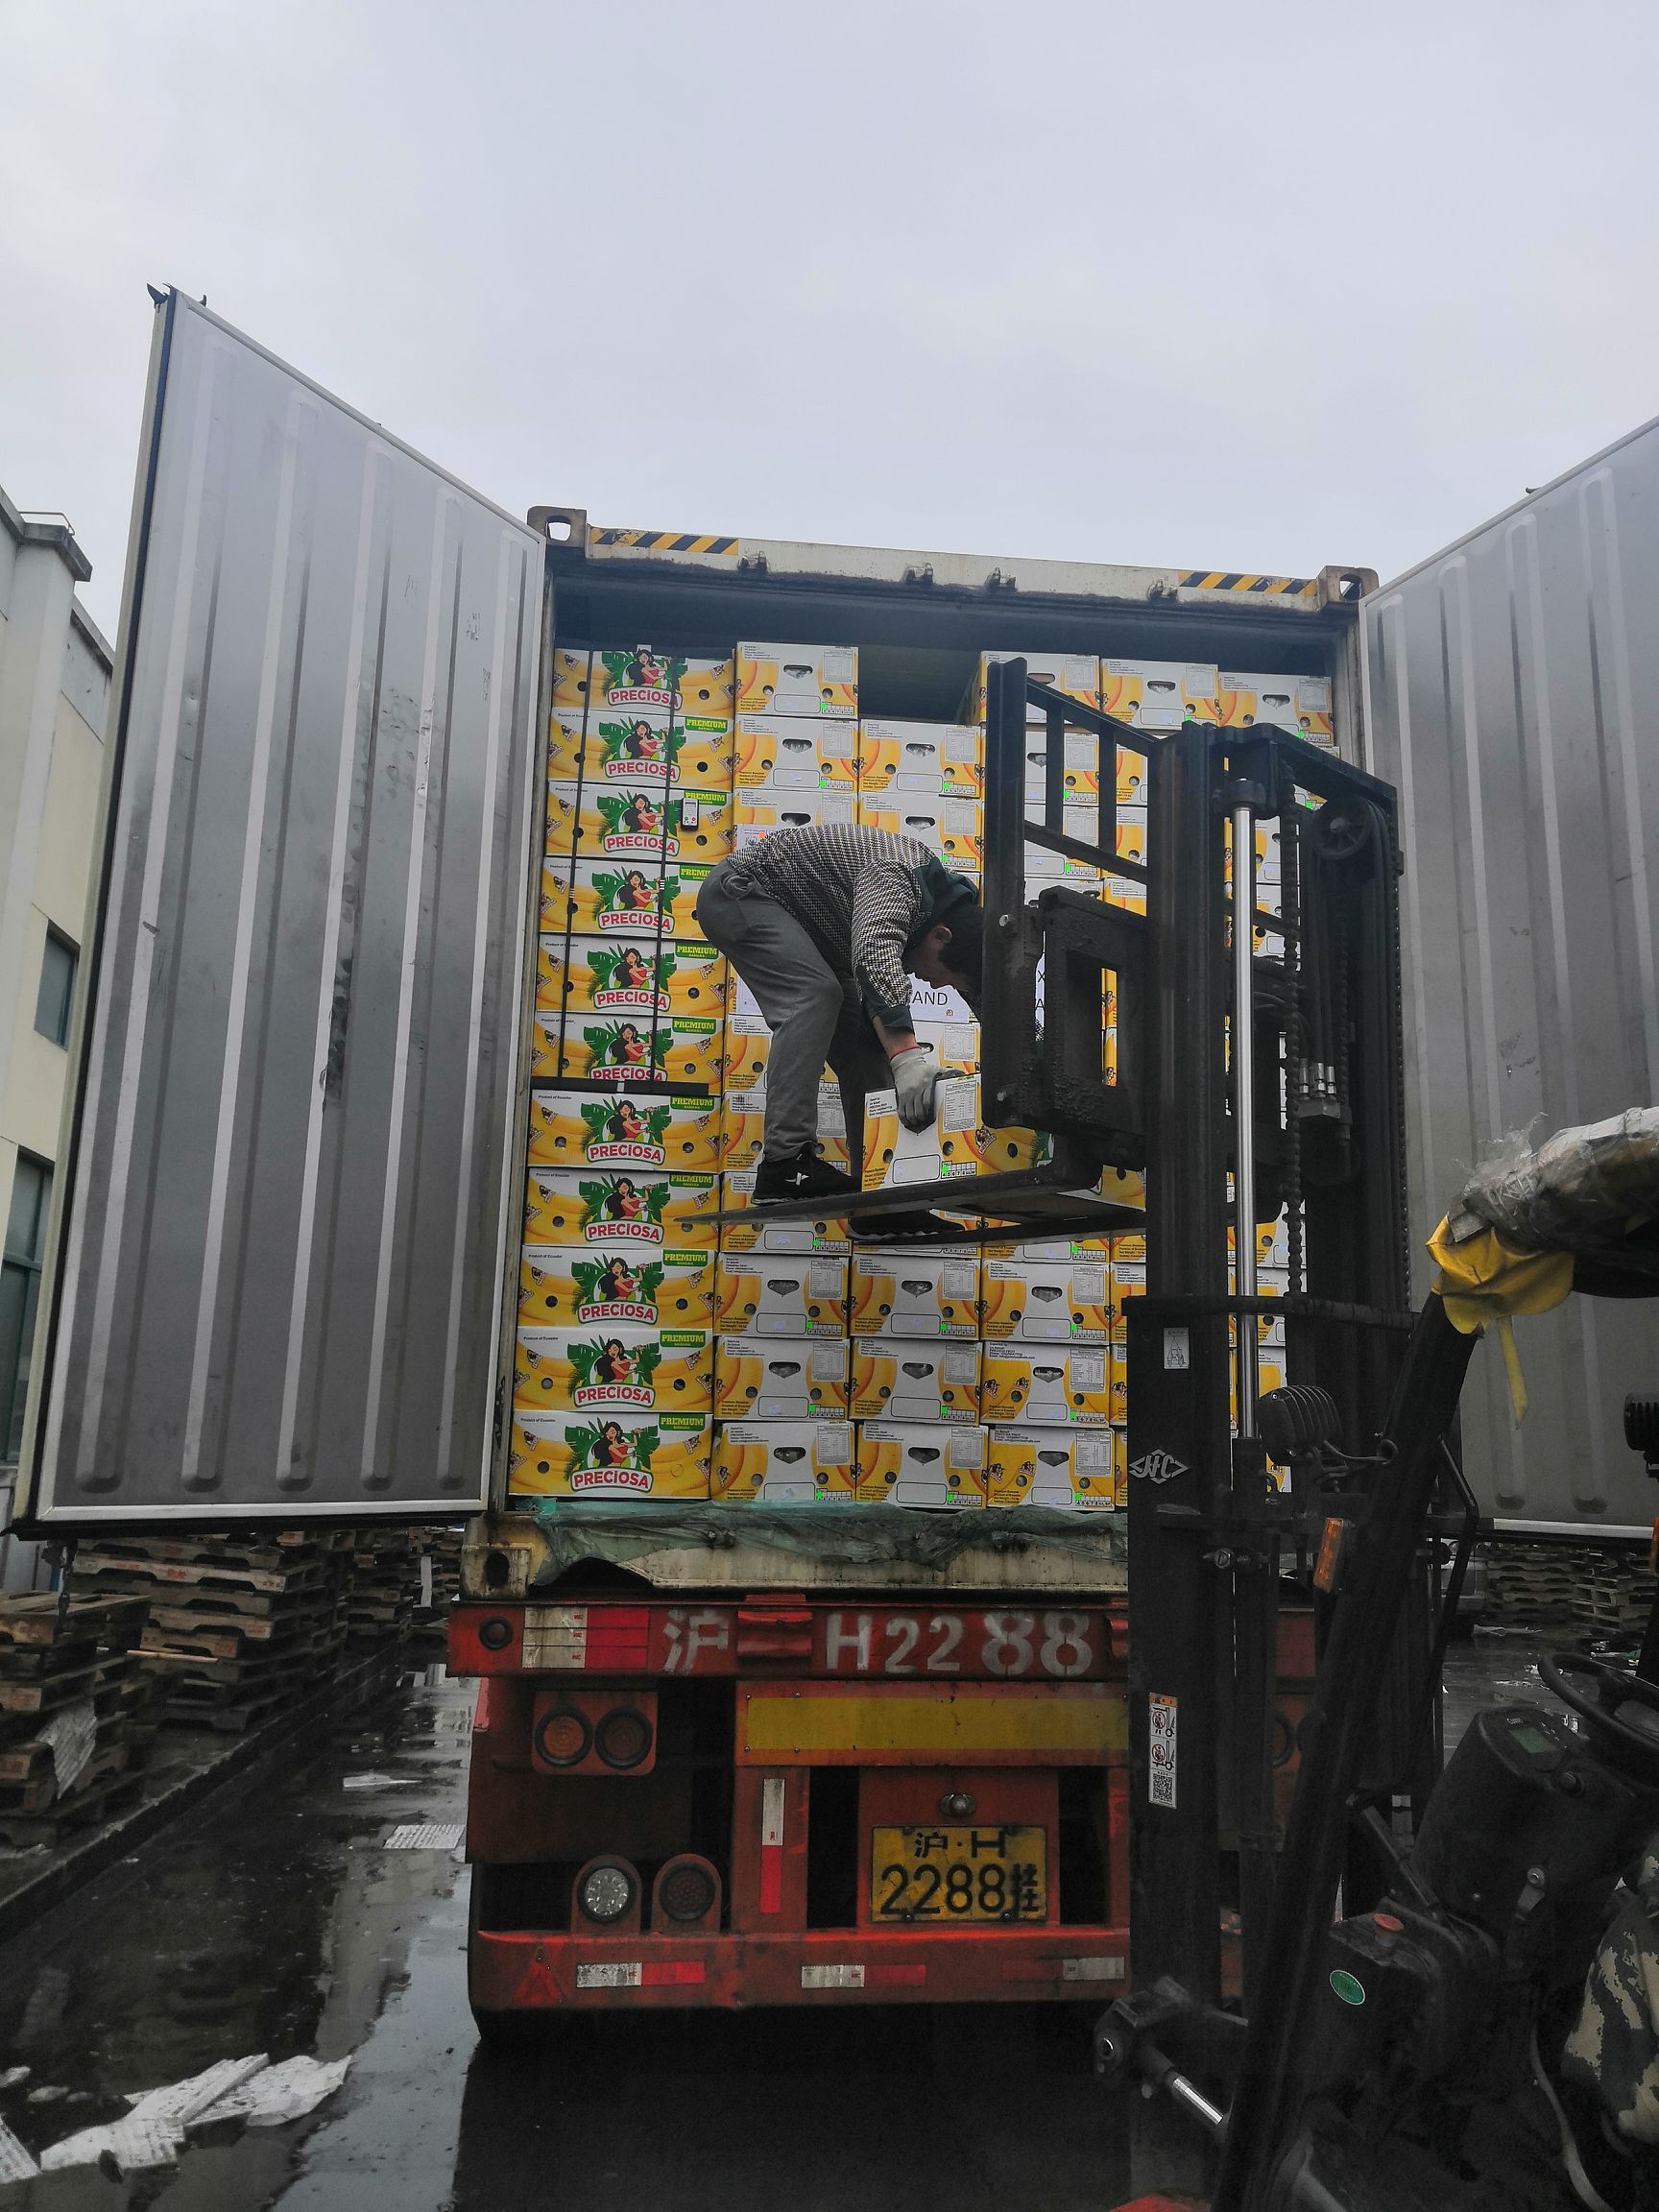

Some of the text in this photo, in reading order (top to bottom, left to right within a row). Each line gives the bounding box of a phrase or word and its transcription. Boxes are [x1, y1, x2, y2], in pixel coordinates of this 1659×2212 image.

[686, 719, 726, 729] PREMIUM
[681, 868, 710, 877] PREMI
[677, 946, 718, 955] PREMIUM
[674, 1021, 715, 1030] PREMIUM
[671, 1097, 713, 1106] PREMIUM
[670, 1174, 712, 1184] PREMIUM
[664, 1253, 708, 1262] PREMIUM
[661, 1334, 705, 1342] PREMIUM
[661, 1417, 704, 1426] PREMIUM
